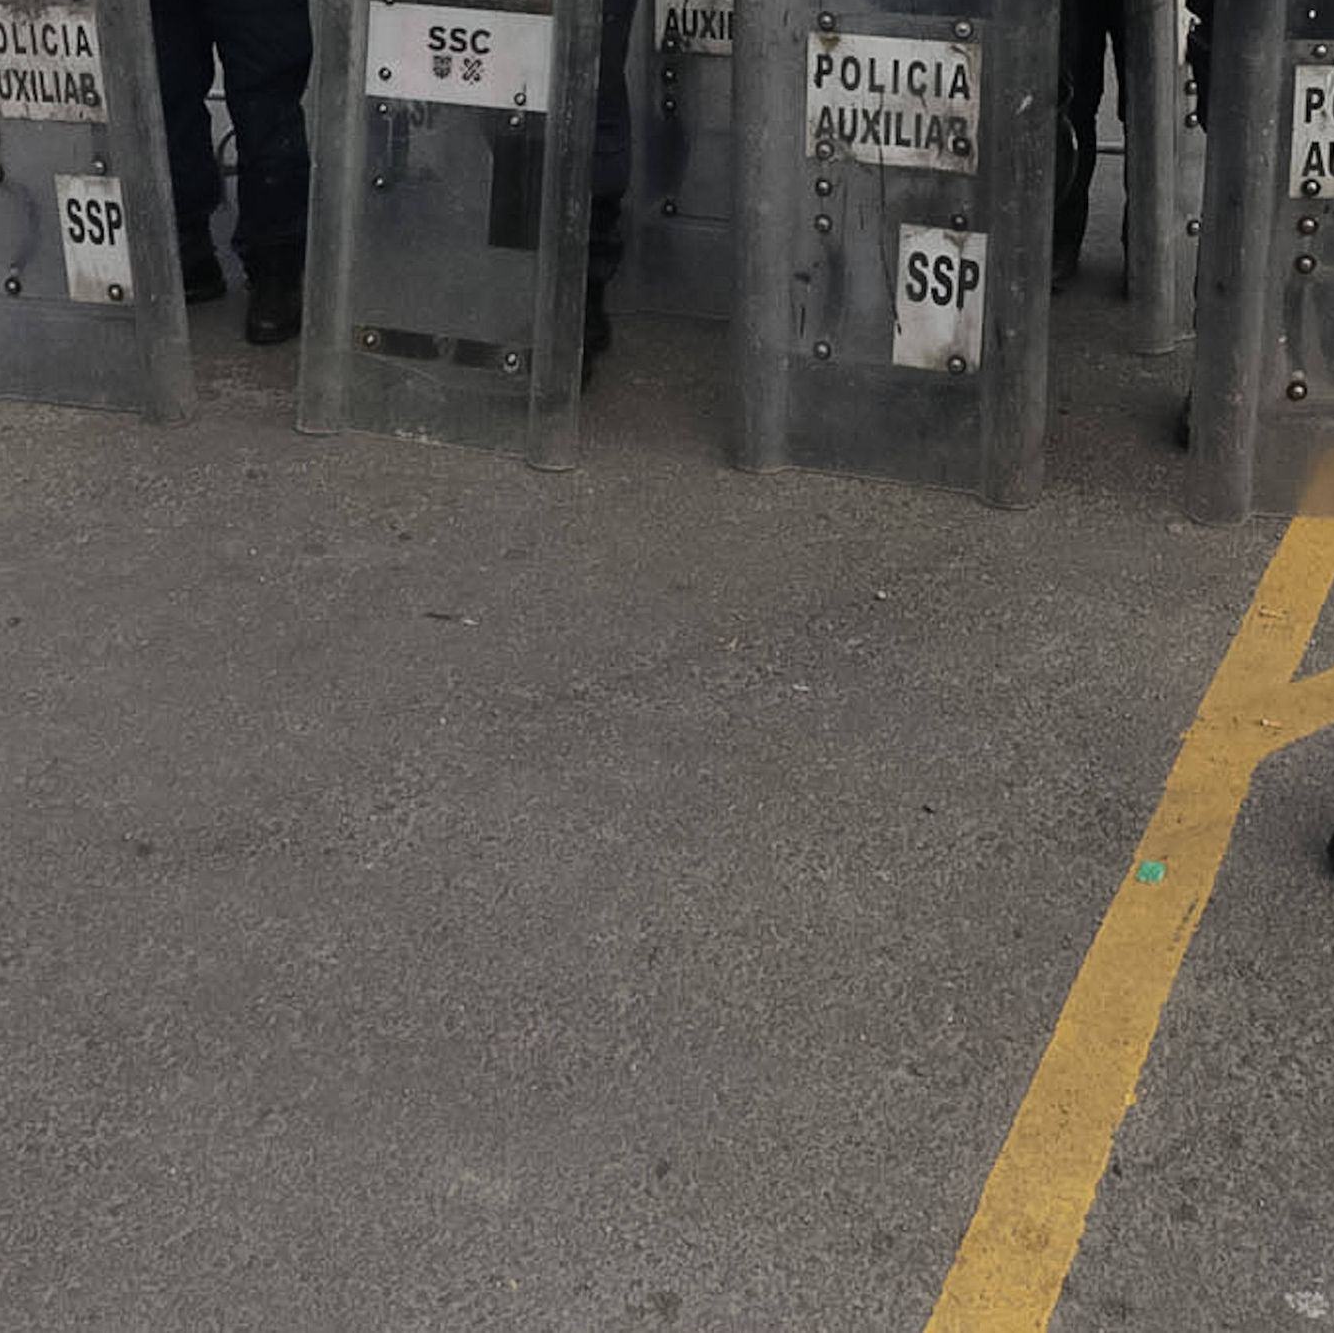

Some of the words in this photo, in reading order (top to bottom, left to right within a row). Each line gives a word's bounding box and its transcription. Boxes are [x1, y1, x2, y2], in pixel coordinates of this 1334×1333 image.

[428, 25, 492, 54] SSC
[665, 7, 733, 43] AUXI
[815, 52, 971, 101] POLICIA
[66, 197, 123, 246] SSP
[905, 250, 981, 310] SSP
